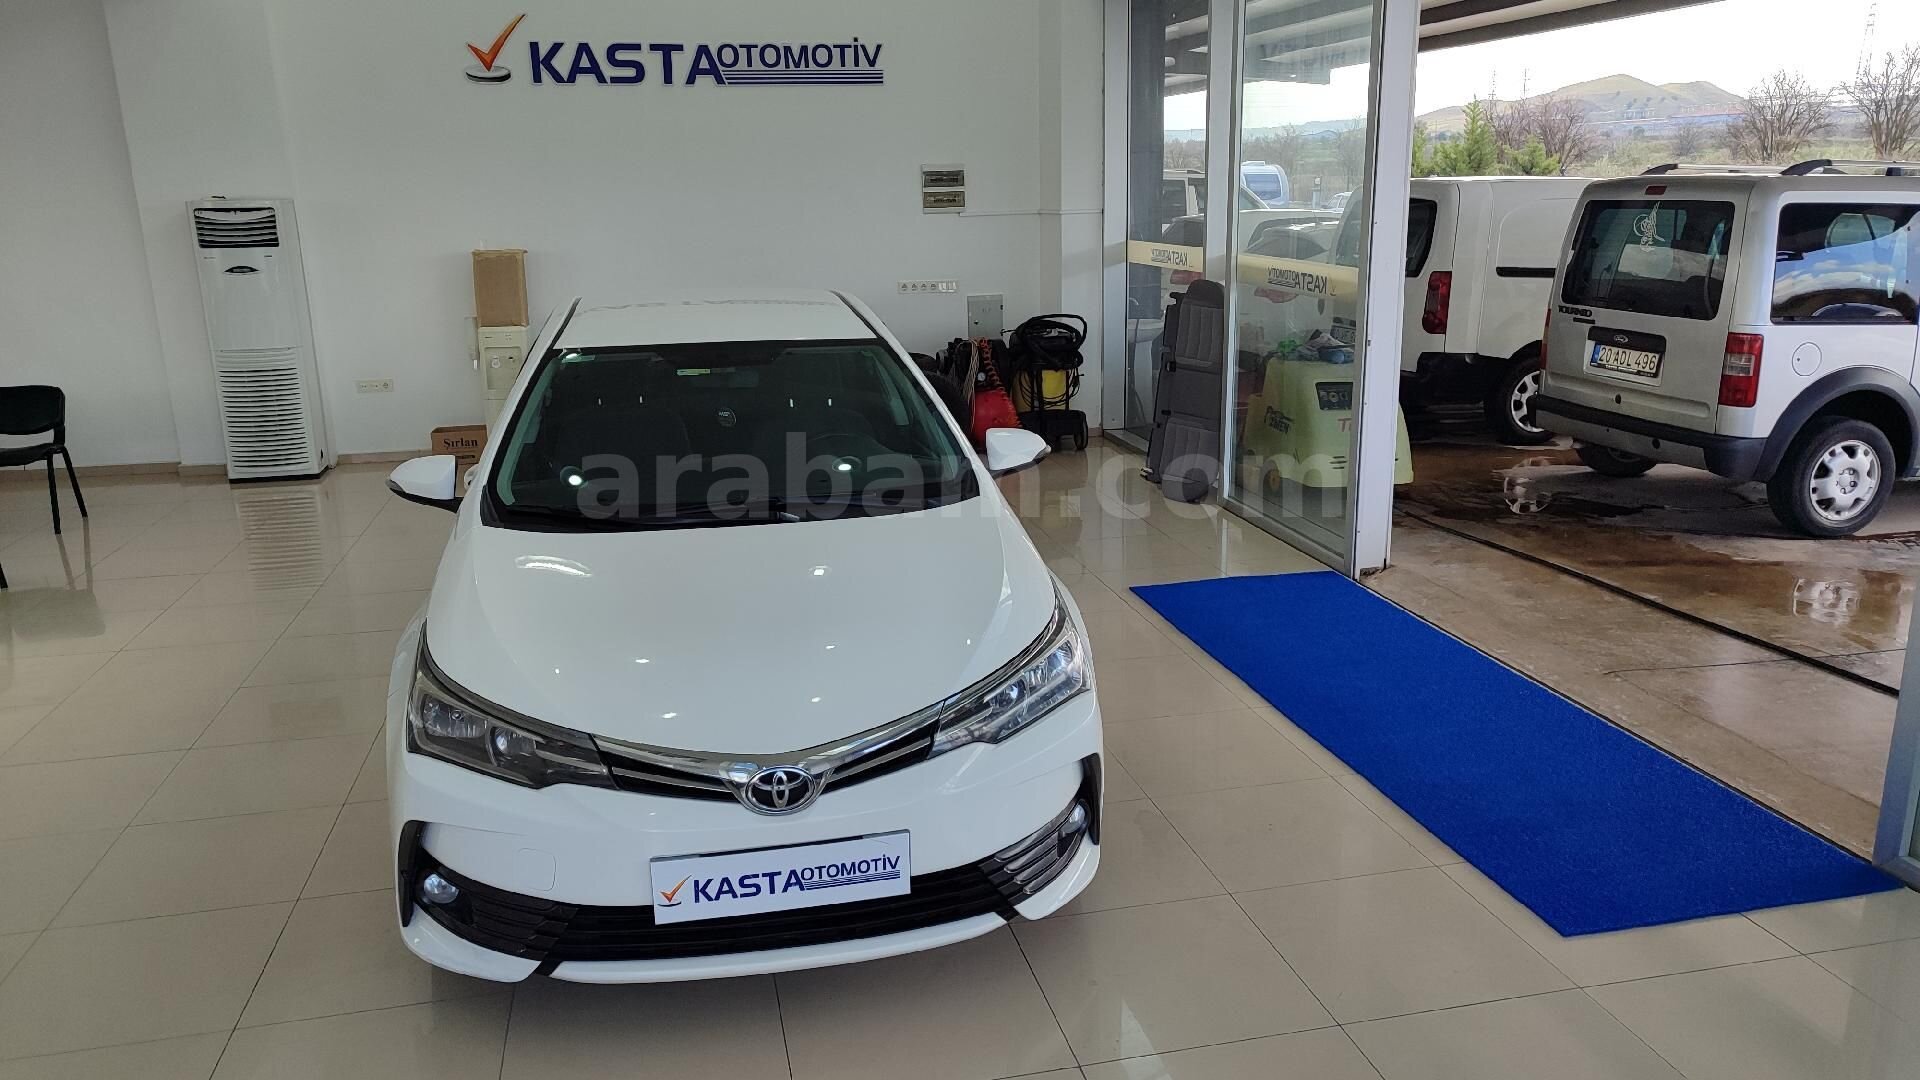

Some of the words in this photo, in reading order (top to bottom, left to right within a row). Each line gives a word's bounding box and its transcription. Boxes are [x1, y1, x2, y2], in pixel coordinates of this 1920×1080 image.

[529, 41, 727, 85] KASTA
[716, 37, 883, 69] OTOMOTİV
[1599, 347, 1613, 363] 20
[1612, 349, 1632, 367] ADL
[1634, 352, 1657, 371] 496
[693, 869, 806, 904] KASTA
[800, 853, 901, 881] OTOMOTİV
